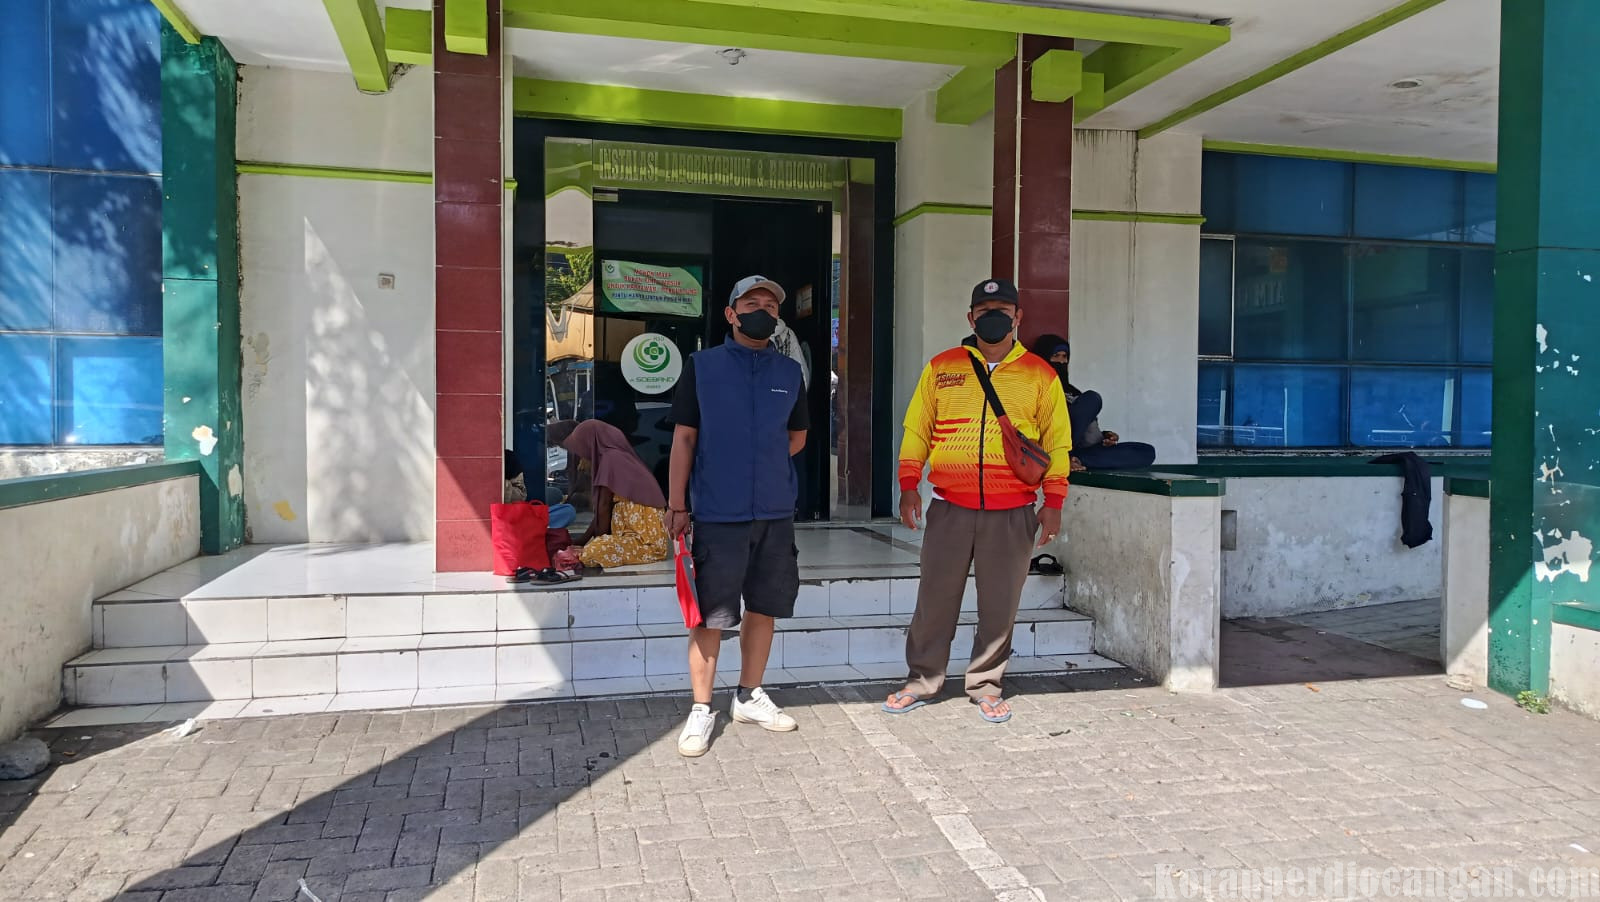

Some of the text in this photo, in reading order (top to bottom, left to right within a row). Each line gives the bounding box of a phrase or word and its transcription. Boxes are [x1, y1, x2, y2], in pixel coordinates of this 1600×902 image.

[599, 148, 828, 191] INSTALASI LABORATORIUM & RADIOLOGI
